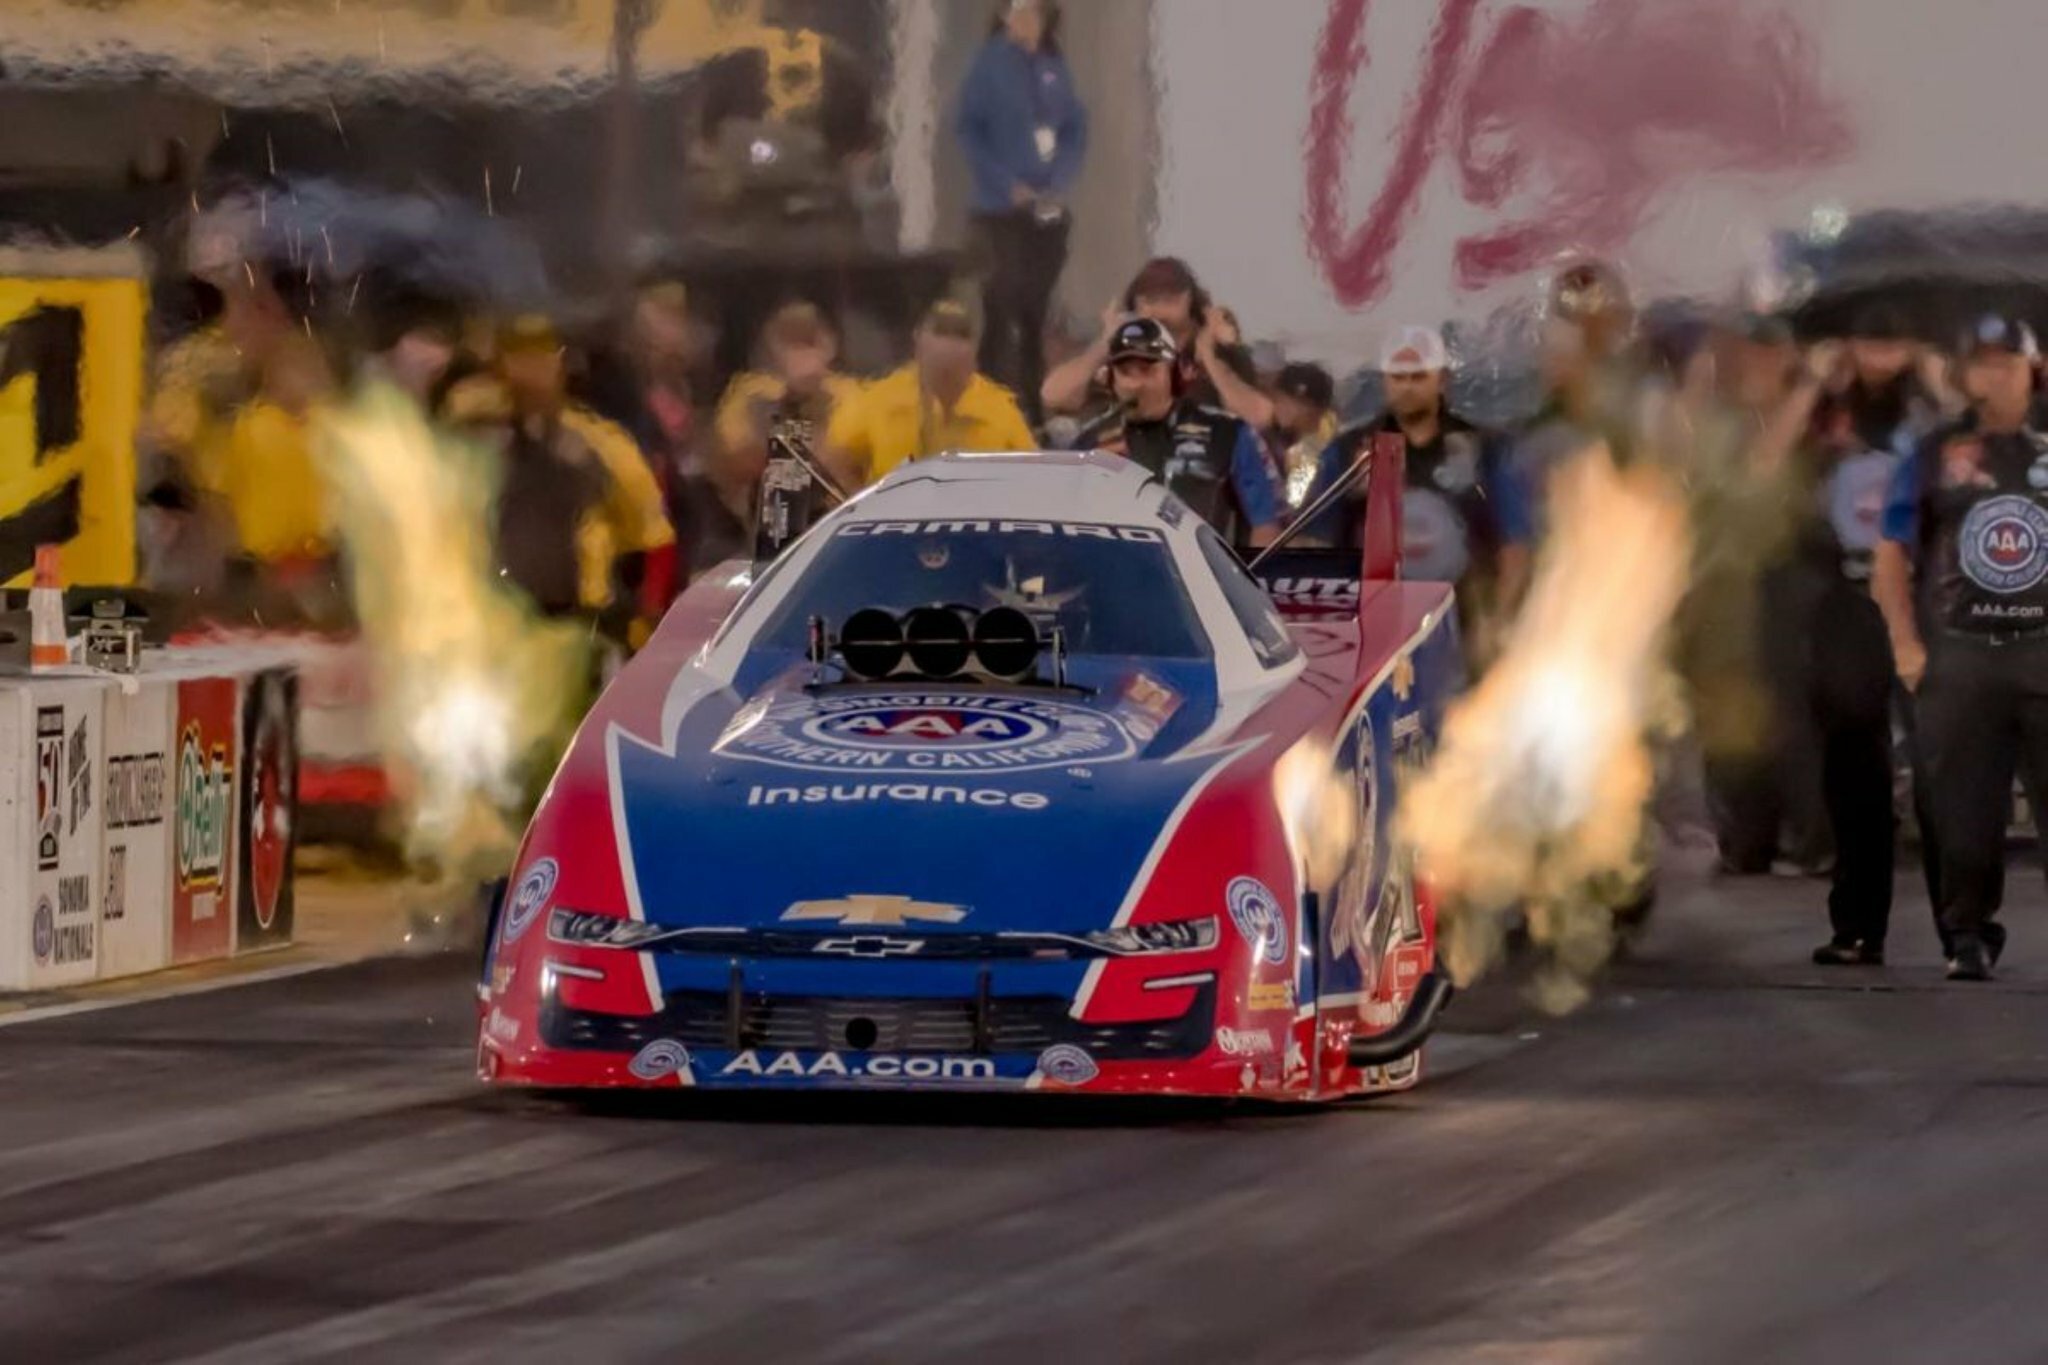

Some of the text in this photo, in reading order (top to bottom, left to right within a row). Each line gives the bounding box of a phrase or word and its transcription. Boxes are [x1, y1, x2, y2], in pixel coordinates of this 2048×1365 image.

[836, 519, 1164, 544] CAMARO
[1986, 529, 2030, 552] AAA
[1971, 603, 2044, 617] AAA.com
[833, 713, 1012, 736] AAA
[905, 731, 1111, 768] CALIFO
[747, 783, 1050, 810] Insurance
[722, 1050, 996, 1079] AAA.com
